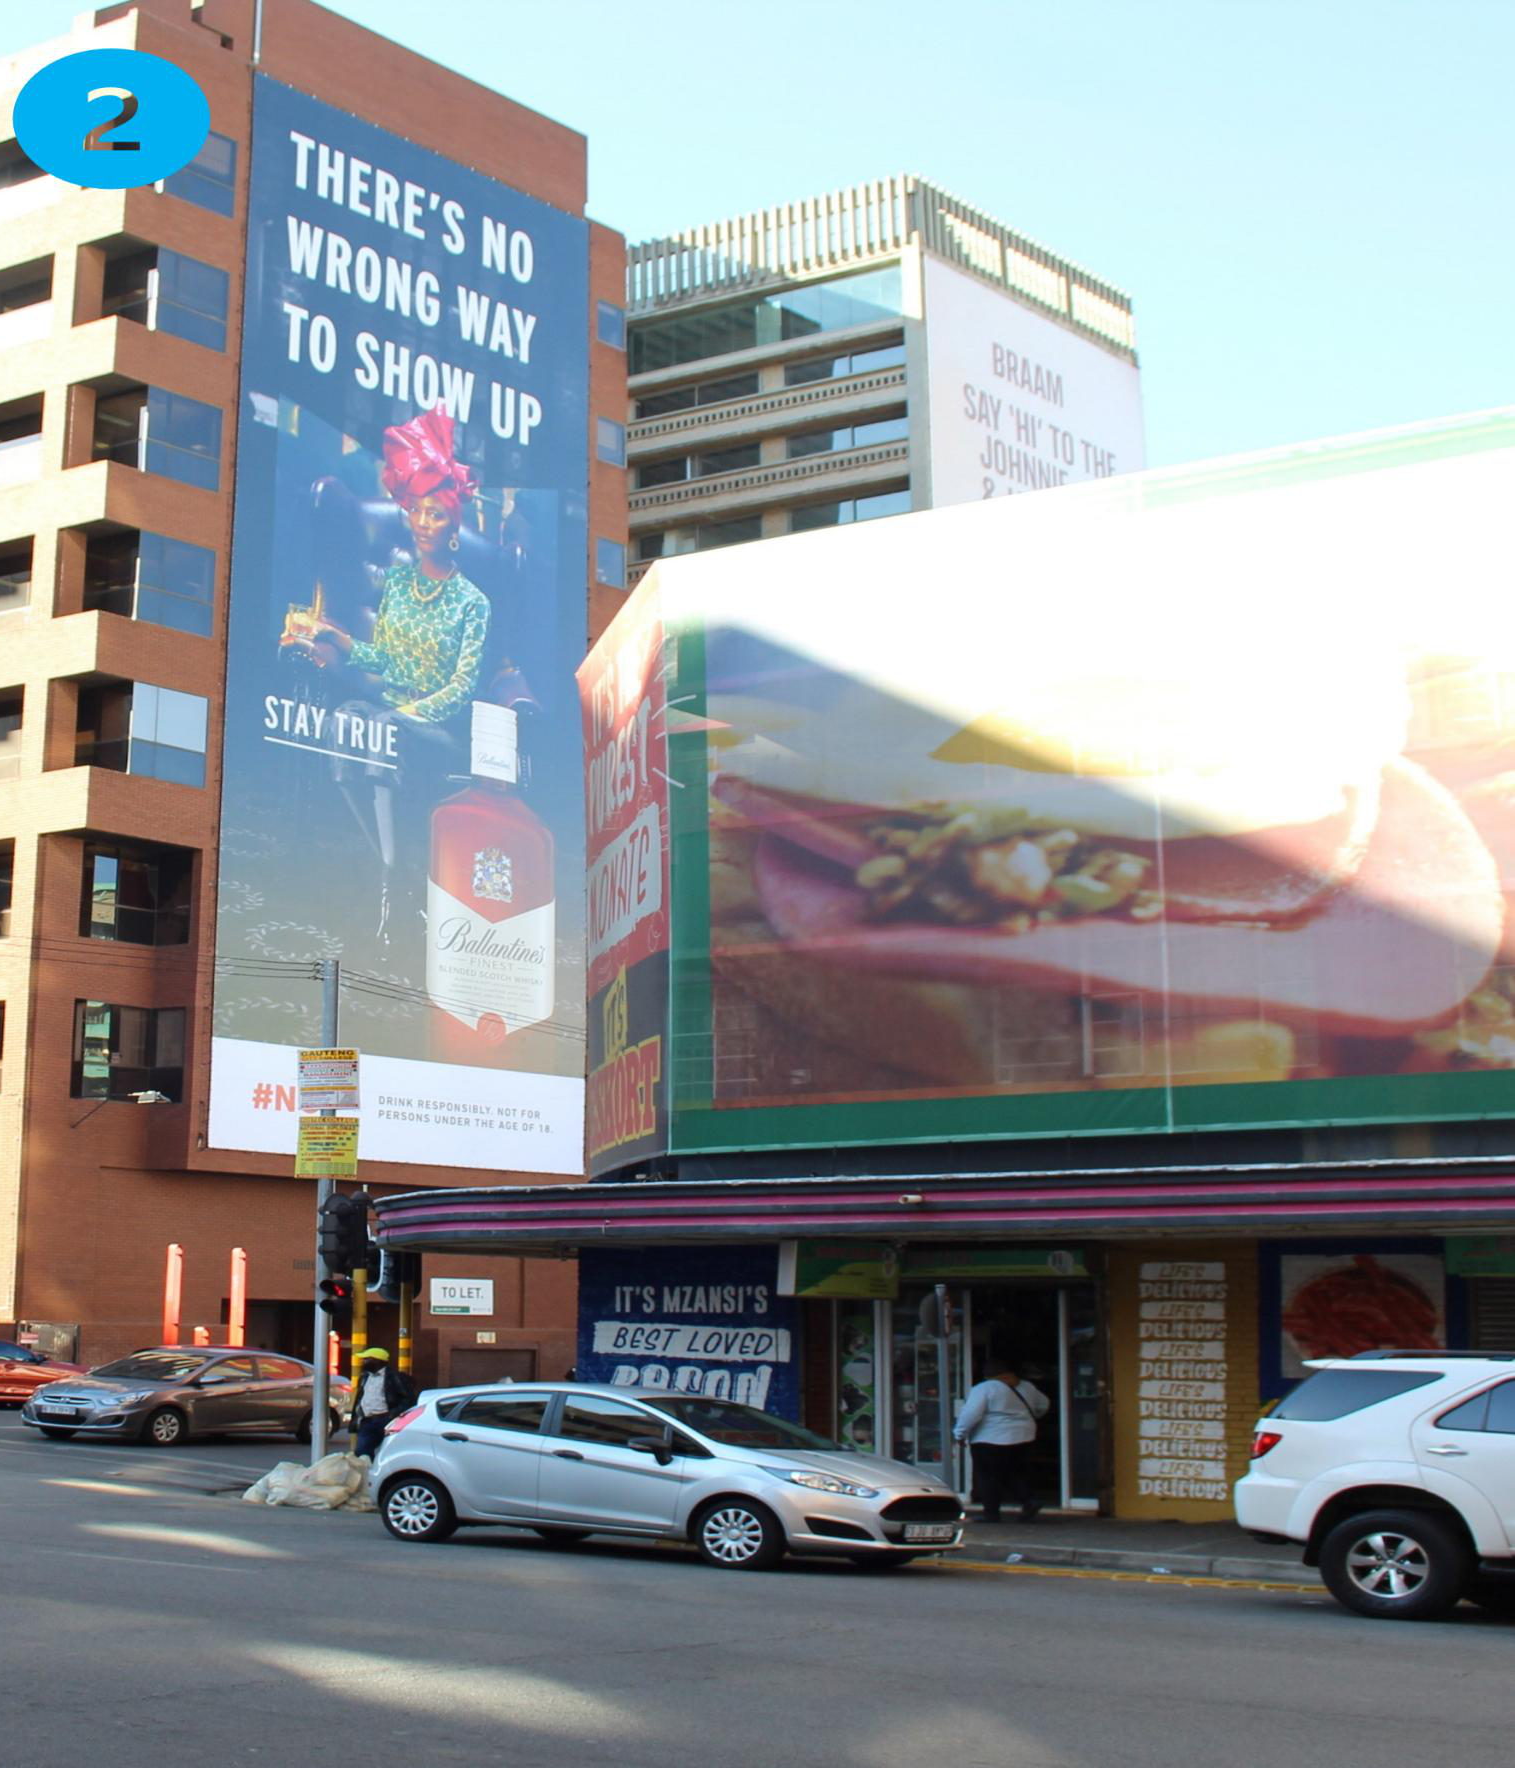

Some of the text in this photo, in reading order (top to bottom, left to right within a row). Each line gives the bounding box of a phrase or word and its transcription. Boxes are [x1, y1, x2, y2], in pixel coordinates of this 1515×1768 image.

[290, 130, 535, 284] THERE'S NO
[286, 215, 538, 366] WRONG WAY
[283, 301, 543, 447] TO SHOW UP
[992, 341, 1064, 409] BRAAM
[963, 382, 1003, 431] SAY
[1048, 424, 1075, 467] TO
[264, 694, 398, 758] STAY TRUE
[469, 957, 515, 972] FINEST
[378, 1095, 414, 1108] DRINK
[497, 1107, 518, 1118] NOT
[520, 1109, 541, 1120] FOR
[378, 1109, 431, 1124] PERSONS
[434, 1114, 471, 1127] UNDER
[475, 1118, 495, 1129] THE
[498, 1120, 519, 1132] AGE
[522, 1122, 535, 1133] OF
[441, 1286, 457, 1299] TO
[614, 1285, 768, 1315] IT'S MZANSI'S
[613, 1326, 774, 1356] BEST LOVED
